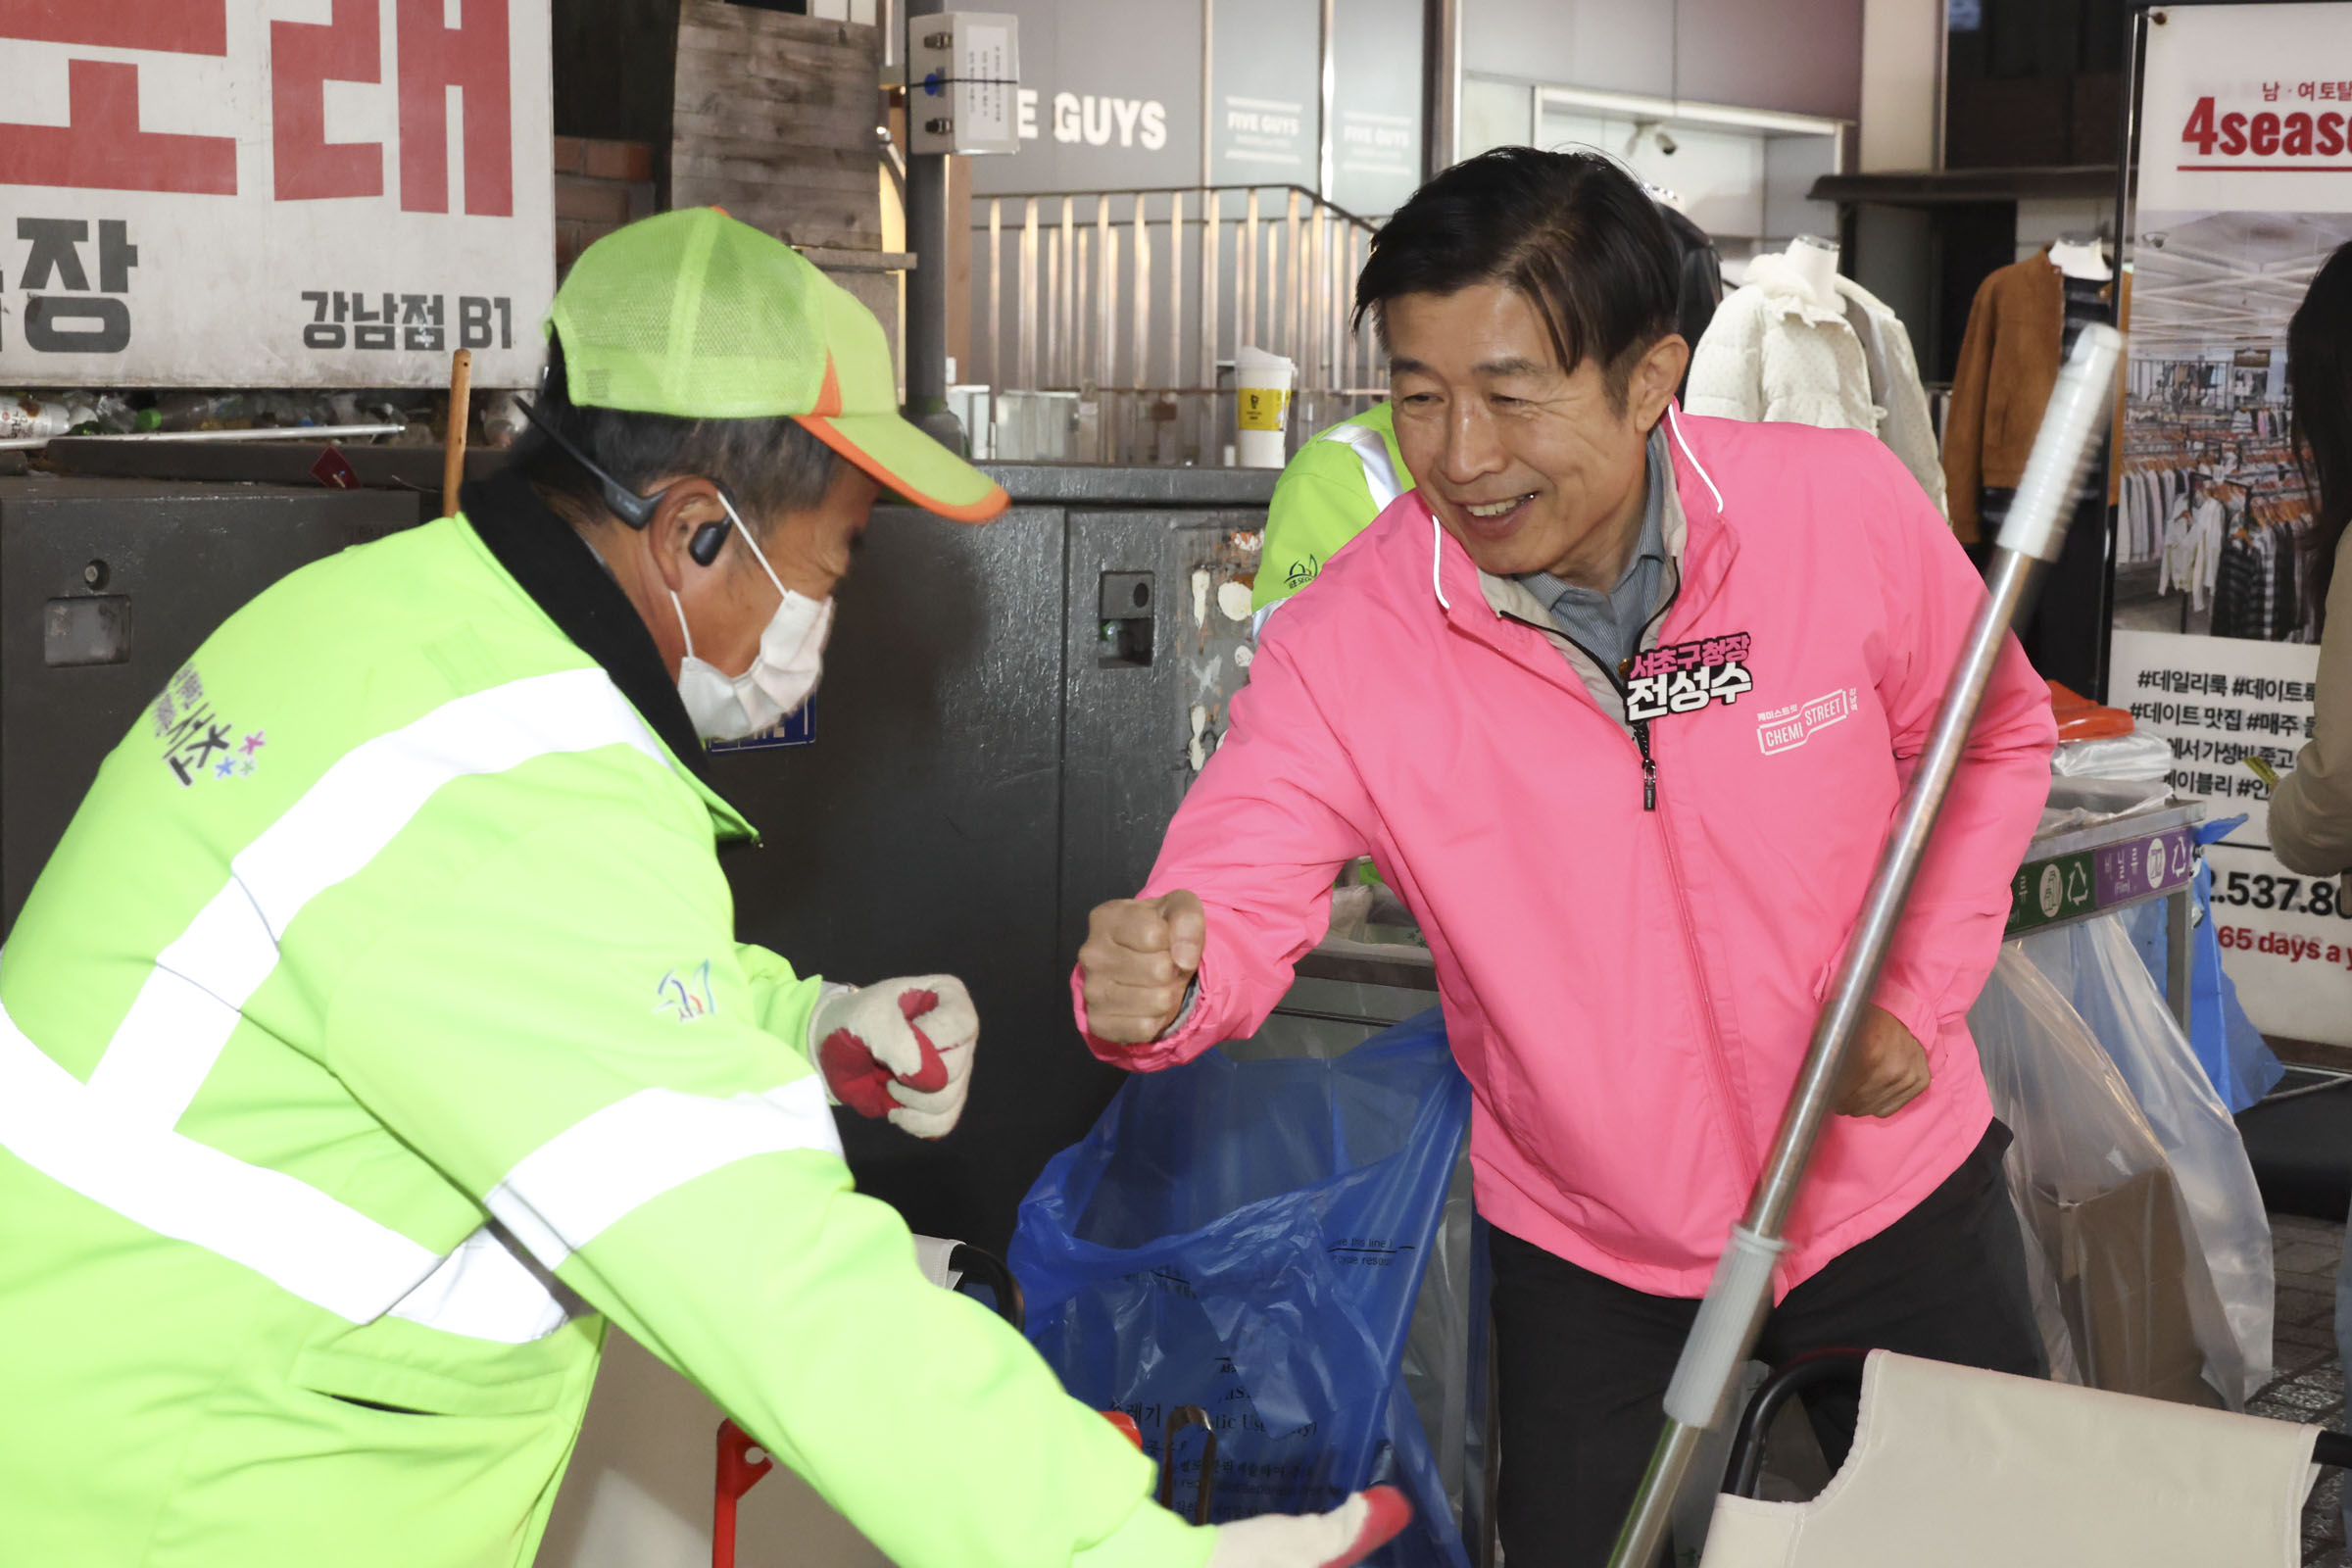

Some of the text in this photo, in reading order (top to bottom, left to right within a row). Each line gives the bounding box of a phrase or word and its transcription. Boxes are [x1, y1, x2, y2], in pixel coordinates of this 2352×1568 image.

[1054, 93, 1166, 150] GUYS
[2181, 96, 2352, 157] 4seas
[0, 218, 138, 353] 장
[302, 291, 512, 351] 강남점 B1
[1630, 635, 1749, 678] 서초구청장
[1627, 662, 1752, 721] 전성수
[2137, 669, 2229, 697] #데일리룩
[1765, 697, 1840, 747] CHEMI STREET
[2131, 702, 2199, 726] #데이트
[2204, 707, 2241, 732] 맛집
[2246, 712, 2298, 737] #매주
[2202, 741, 2254, 765] 가성비
[2210, 870, 2352, 919] .537.8
[2216, 925, 2252, 951] 65
[2257, 932, 2321, 962] days
[2326, 944, 2340, 963] a
